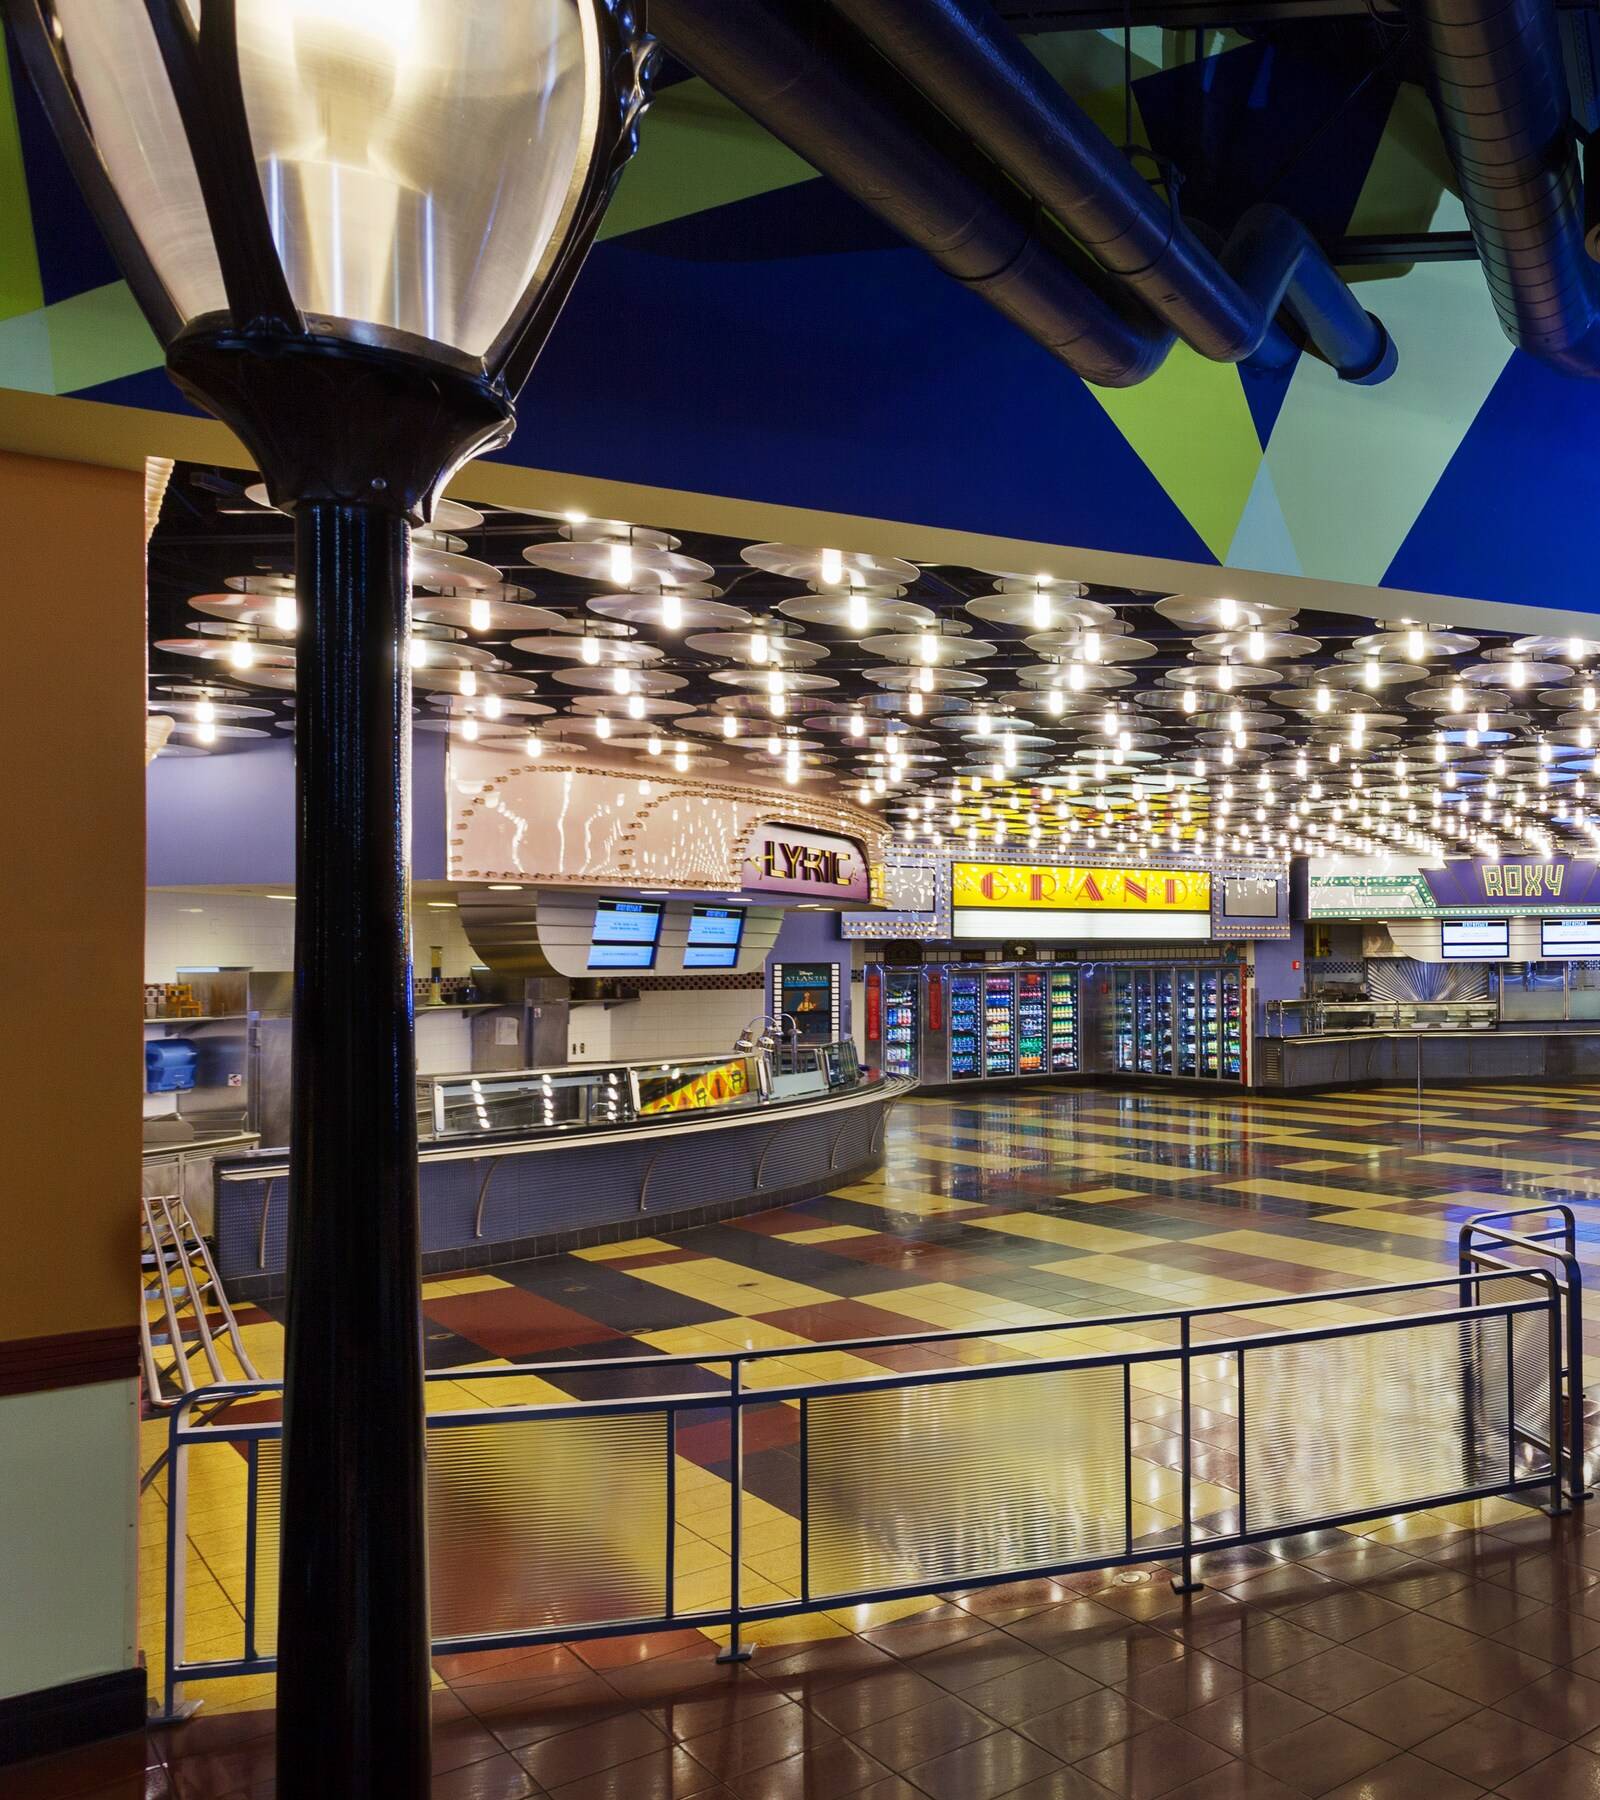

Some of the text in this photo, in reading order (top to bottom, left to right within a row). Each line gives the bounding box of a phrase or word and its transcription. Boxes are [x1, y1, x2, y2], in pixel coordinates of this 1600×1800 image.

[764, 841, 851, 886] LYRIC
[980, 871, 1188, 904] GRAND
[1482, 865, 1565, 896] ROXY
